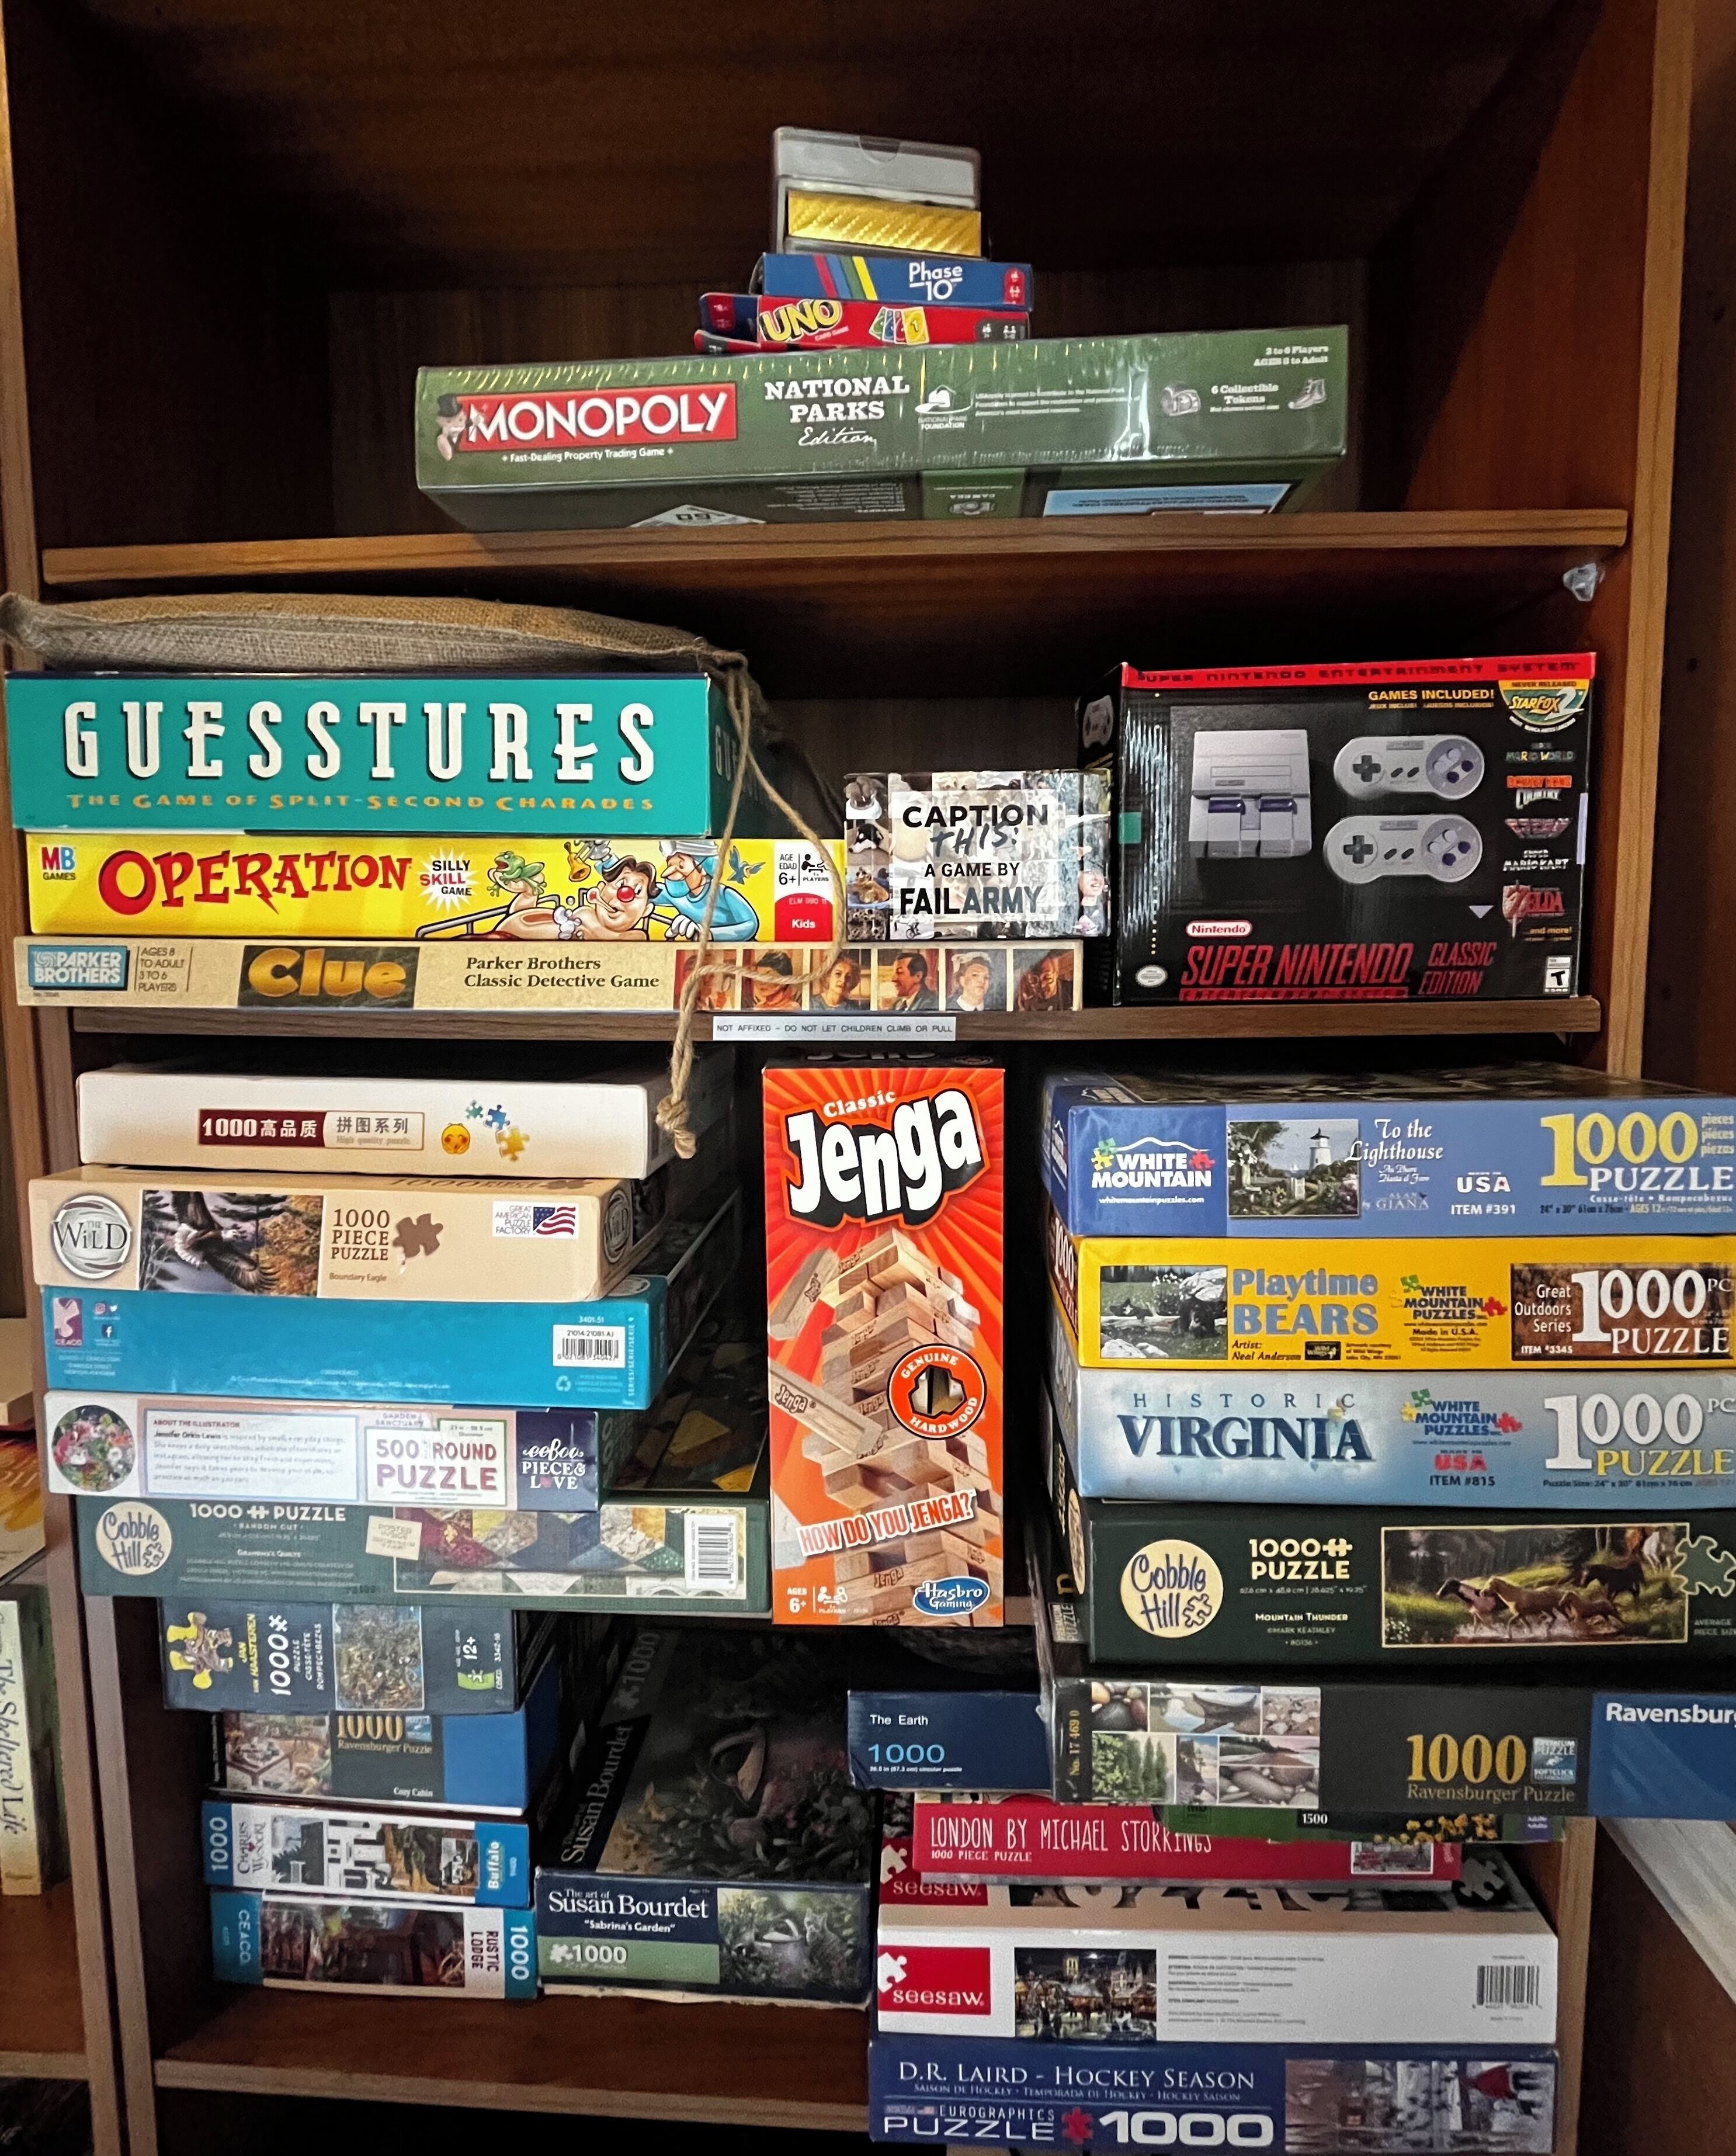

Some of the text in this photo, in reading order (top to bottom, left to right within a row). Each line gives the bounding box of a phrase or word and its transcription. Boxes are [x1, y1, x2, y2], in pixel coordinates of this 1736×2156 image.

[909, 262, 963, 283] Phase
[926, 282, 952, 300] 10
[764, 374, 910, 401] NATIONAL
[1211, 384, 1279, 394] 6 Collectible
[1224, 396, 1265, 404] Tokens
[469, 391, 727, 443] MONOPOLY
[790, 401, 885, 425] PARKS
[509, 446, 665, 464] Fast-Dealing Property Trading Game
[1206, 671, 1306, 682] NINTENDO
[1319, 664, 1484, 678] ENTERTAINMENT
[1497, 662, 1579, 674] SYSTEM
[1369, 689, 1494, 701] GAMES INCLUDED!
[64, 700, 655, 784] GUESSTURES
[902, 804, 1048, 828] CAPTION
[41, 846, 75, 871] MB
[432, 859, 470, 872] SILLY
[779, 862, 797, 871] EDAD
[780, 854, 793, 863] AGE
[42, 871, 76, 881] GAMES
[925, 862, 1020, 877] A GAME BY
[98, 849, 412, 916] OPERATION
[419, 872, 466, 886] SKILL
[778, 872, 797, 886] 6+
[441, 886, 472, 897] GAME
[791, 918, 815, 930] Kids
[1192, 924, 1248, 934] Nintendo
[57, 951, 121, 969] PARKER
[141, 947, 175, 958] AGES 8
[140, 958, 184, 969] TO ADULT
[467, 956, 601, 970] Parker Brothers
[1181, 941, 1498, 986] SUPER NINTENDO CLASSIC
[34, 966, 121, 985] BROTHERS
[138, 970, 168, 980] 3 TO 6
[248, 948, 407, 999] Clue
[465, 974, 659, 989] Classic Detective Game
[1551, 970, 1565, 986] T
[138, 982, 177, 993] PLAYERS
[1418, 970, 1484, 995] EDITION
[717, 1024, 732, 1032] NOT
[738, 1024, 771, 1032] AFFIXED
[784, 1024, 797, 1032] DO
[801, 1024, 818, 1032] NOT
[823, 1090, 897, 1118] Classic
[336, 1117, 408, 1134] 拼图系列
[1701, 1113, 1734, 1126] pieces
[787, 1090, 982, 1216] Jenga
[1540, 1112, 1699, 1186] 1000
[1117, 1153, 1187, 1170] WHITE
[1092, 1171, 1211, 1188] MOUNTAIN
[1457, 1177, 1511, 1193] USA
[1589, 1167, 1734, 1191] PUZZLE
[1099, 1195, 1204, 1205] whitemountainpuzzles.com
[333, 1208, 390, 1228] 1000
[1450, 1204, 1516, 1215] ITEM #391
[495, 1226, 532, 1235] FACTORY
[504, 1219, 531, 1227] PUZZLE
[332, 1229, 389, 1246] PIECE
[331, 1247, 388, 1261] PUZZLE
[329, 1273, 387, 1282] Boundary Eagle
[1232, 1268, 1379, 1302] Playtime
[1421, 1286, 1467, 1297] WHITE
[1536, 1285, 1571, 1299] Great
[1404, 1297, 1483, 1309] MOUNTAIN
[1515, 1302, 1571, 1316] Outdoors
[1233, 1304, 1379, 1335] BEARS
[1413, 1309, 1476, 1320] PUZZLES
[1533, 1320, 1571, 1333] Series
[1231, 1340, 1262, 1349] Artist:
[1612, 1327, 1730, 1354] PUZZLE
[1231, 1351, 1301, 1360] Neal Anderson
[1521, 1346, 1541, 1354] ITEM
[1133, 1393, 1356, 1409] HISTORIC
[1432, 1401, 1480, 1413] WHITE
[1415, 1413, 1497, 1424] MOUNTAIN
[1117, 1413, 1375, 1461] VIRGINIA
[1425, 1424, 1490, 1436] PUZZLES
[376, 1439, 497, 1461] 500 ROUND
[1434, 1454, 1487, 1472] USA
[1596, 1449, 1735, 1476] PUZZLE
[377, 1464, 497, 1491] PUZZLE
[1429, 1475, 1495, 1486] ITEM #815
[190, 1503, 346, 1521] 1000 PUZZLE
[102, 1512, 159, 1541] Cobble
[799, 1492, 973, 1554] HOW DO YOU JENGA?
[112, 1542, 140, 1571] Hill
[1249, 1539, 1321, 1558] 1000
[1131, 1553, 1206, 1593] Cobble
[1251, 1560, 1350, 1580] PUZZLE
[917, 1581, 982, 1599] Hasbro
[789, 1598, 807, 1613] 6+
[929, 1596, 972, 1610] Gaming
[1140, 1594, 1180, 1631] Hill
[1306, 1613, 1348, 1621] THUNDER
[463, 1636, 478, 1660] 12+
[268, 1634, 291, 1696] 1000
[336, 1715, 402, 1741] 1000
[870, 1714, 929, 1726] The Earth
[1070, 1719, 1081, 1739] 469
[338, 1739, 432, 1754] Ravensburger Puzzle
[868, 1743, 945, 1763] 1000
[1070, 1742, 1080, 1755] 17
[1533, 1746, 1575, 1755] PUZZLE
[1070, 1758, 1081, 1776] No.
[1406, 1734, 1527, 1783] 1000
[393, 1787, 433, 1797] Cozy Cabin
[1302, 1812, 1328, 1824] 1500
[210, 1817, 228, 1871] 1000
[931, 1849, 1032, 1862] 1000 PIECE PUZZLE
[487, 1840, 501, 1891] Buffalo
[565, 1888, 610, 1899] The art of
[893, 1878, 979, 1896] seesaw
[549, 1891, 709, 1918] Susan Bourdet
[238, 1909, 251, 1965] CEACO
[471, 1931, 483, 1970] LODGE
[486, 1930, 499, 1973] RUSTIC
[510, 1925, 529, 1981] 1000
[571, 1945, 627, 1964] 1000
[893, 1988, 983, 2006] seesaw
[939, 2106, 1056, 2121] EUROGRAPHICS
[884, 2112, 1273, 2147] PUZZLE 1000
